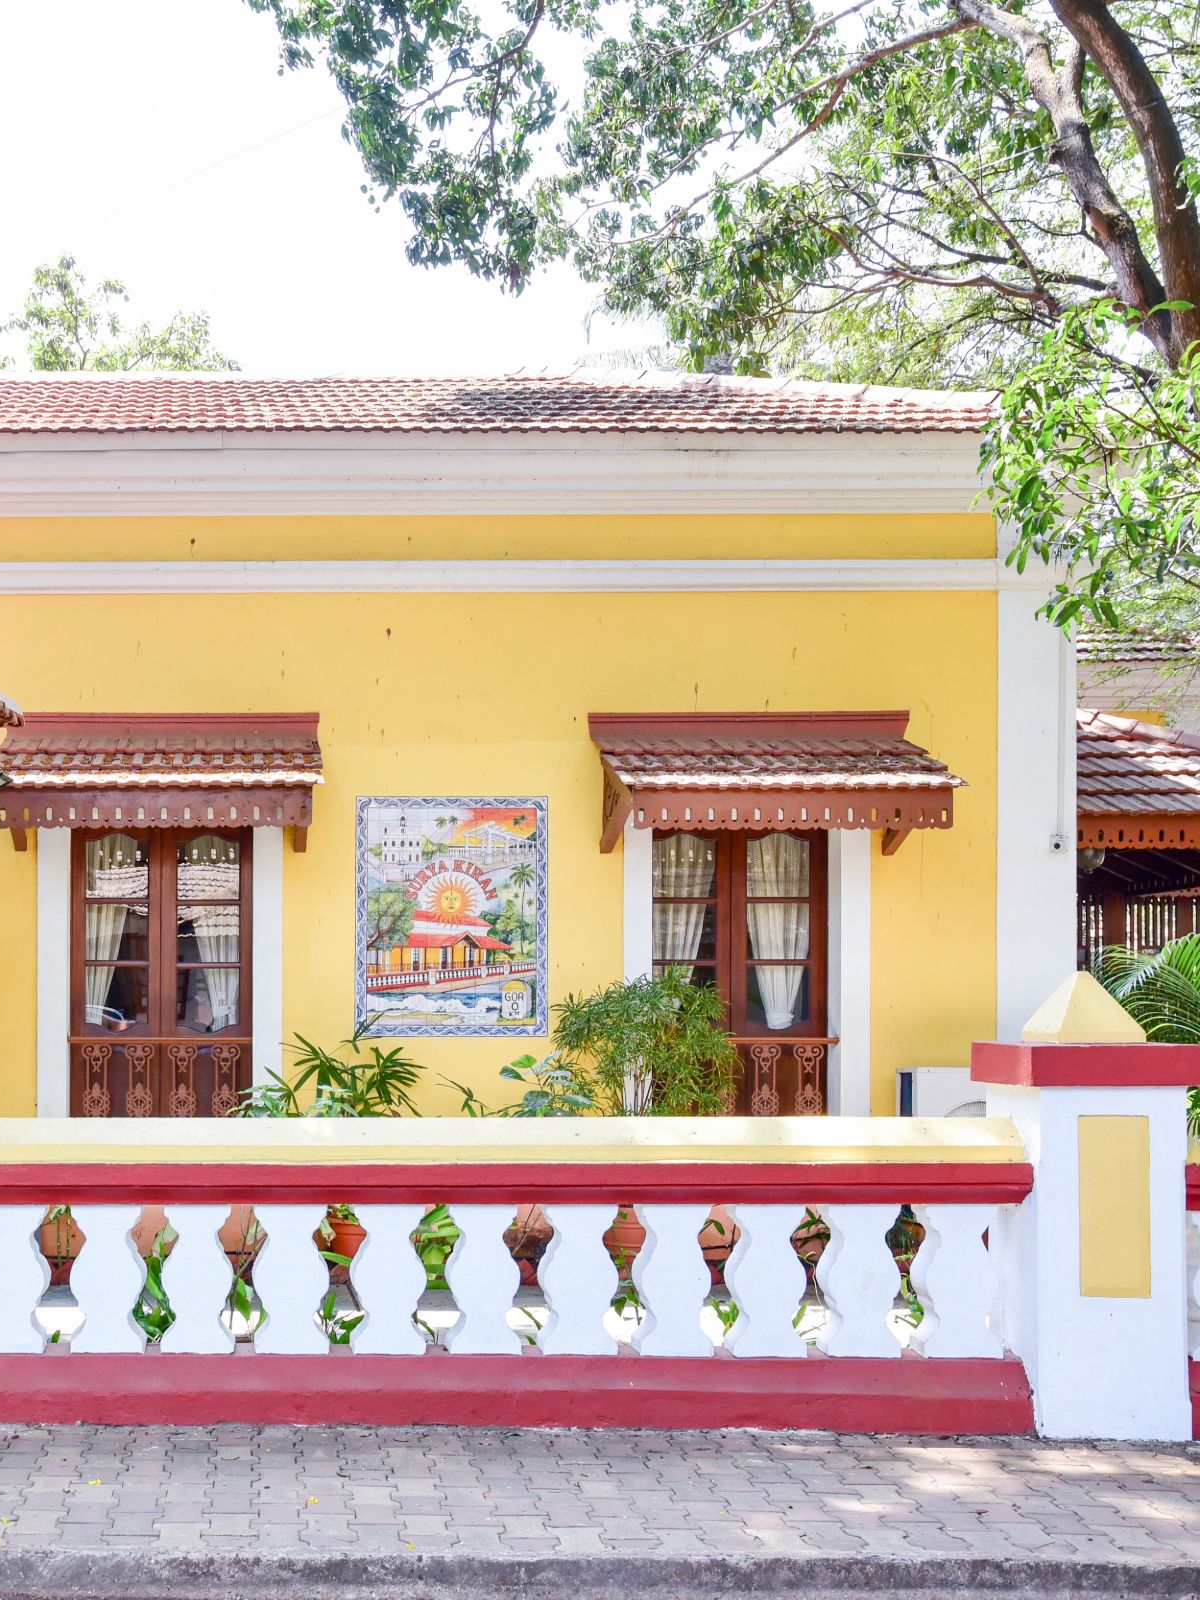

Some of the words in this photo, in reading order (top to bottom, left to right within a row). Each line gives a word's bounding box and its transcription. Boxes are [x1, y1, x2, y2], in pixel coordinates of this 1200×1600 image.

[405, 860, 449, 900] SURYA
[454, 859, 498, 900] KIRAN
[504, 992, 524, 1002] GOA
